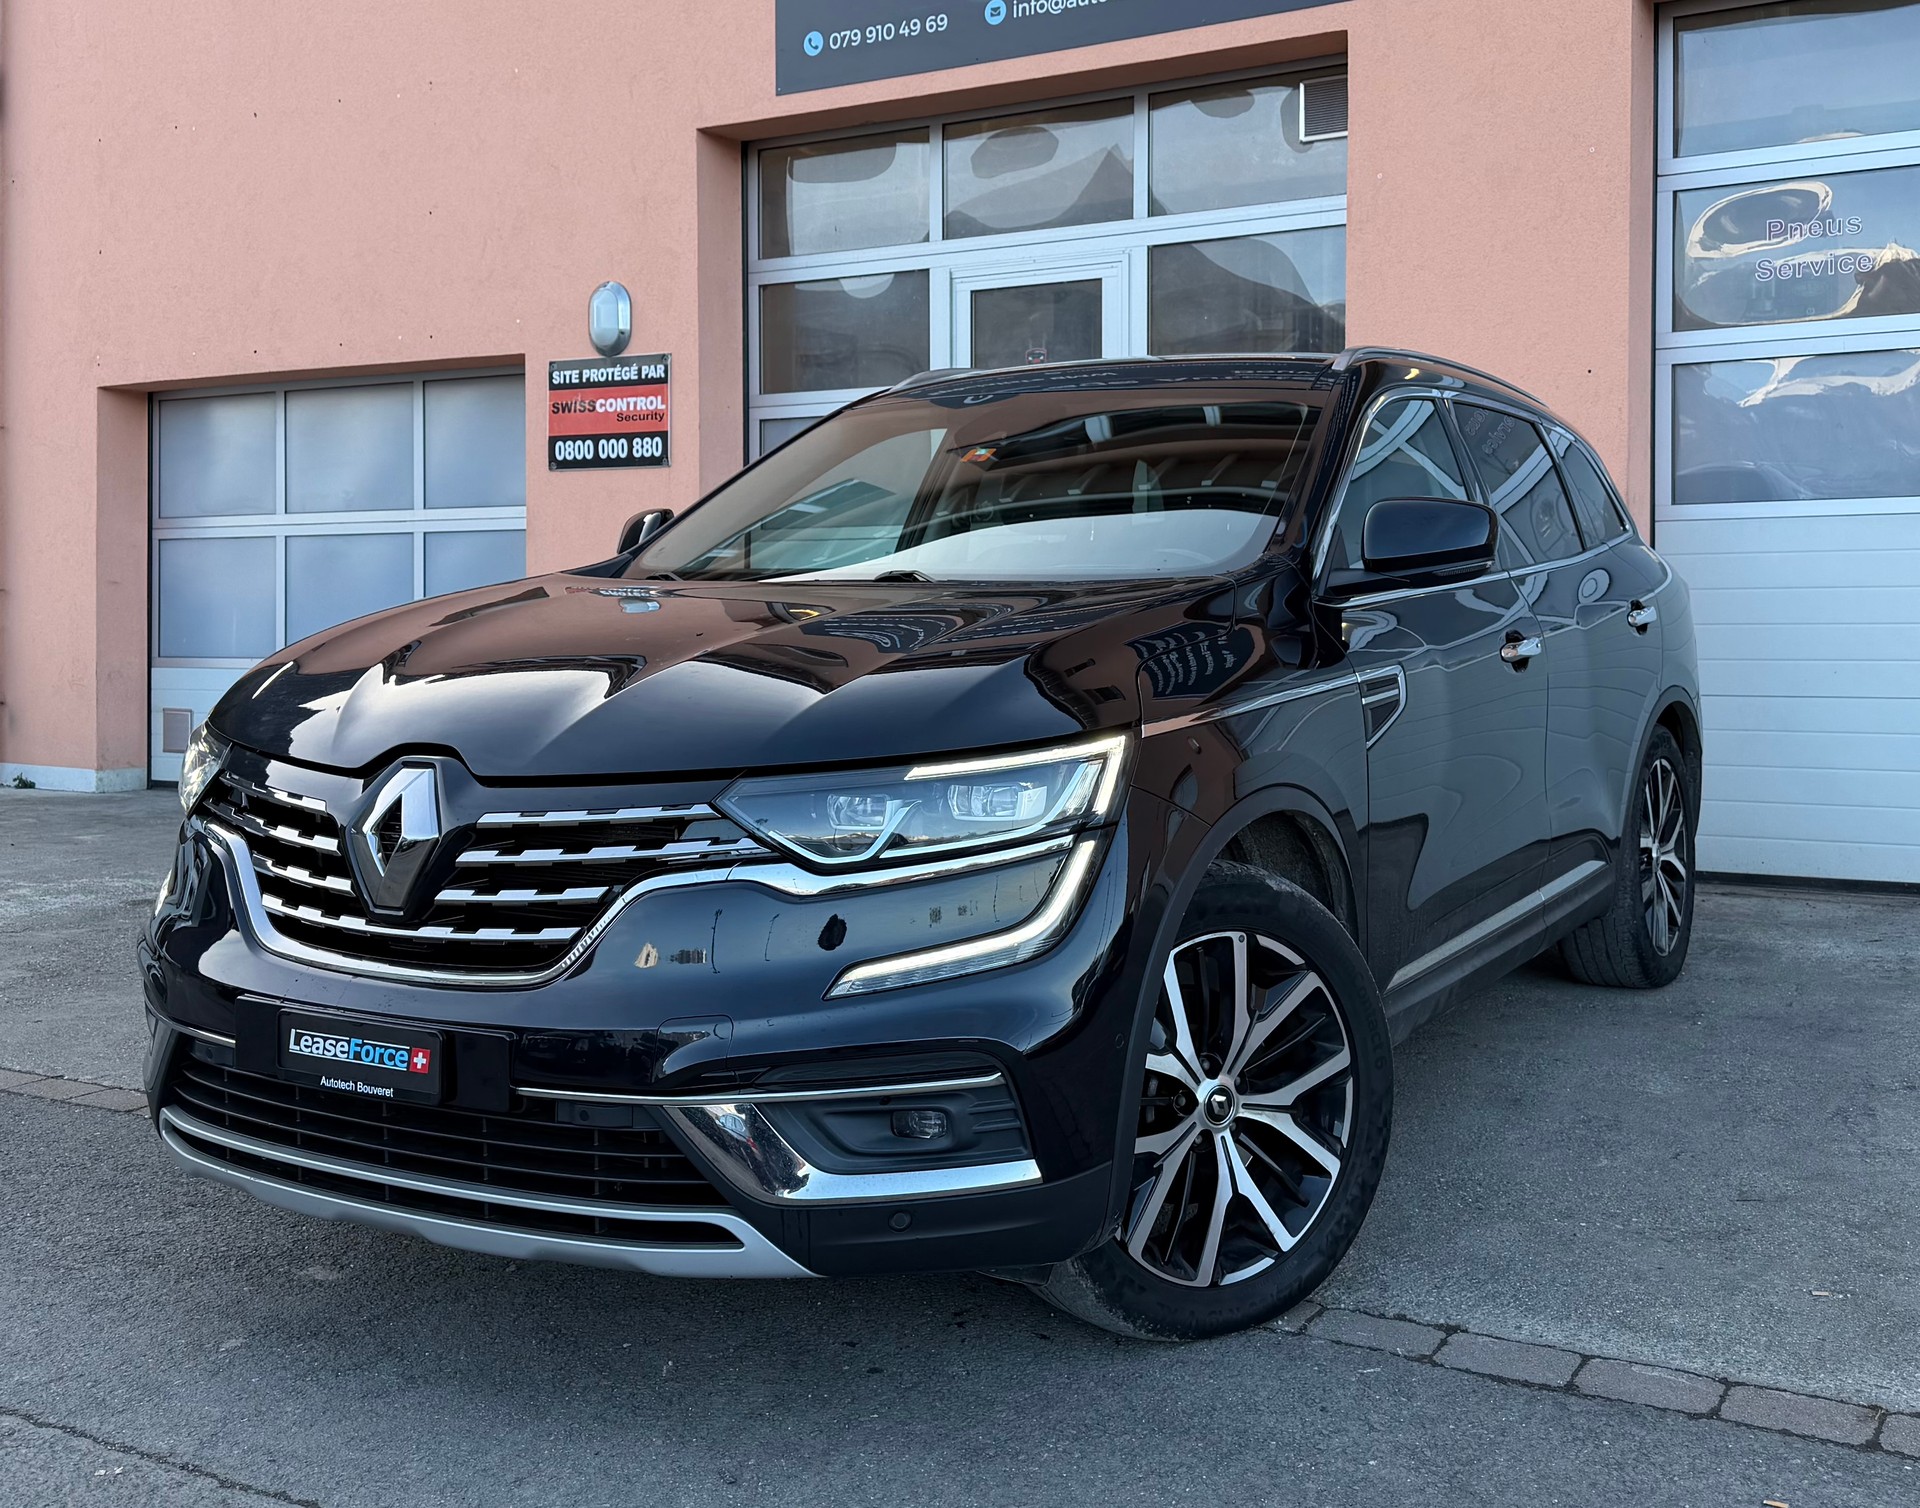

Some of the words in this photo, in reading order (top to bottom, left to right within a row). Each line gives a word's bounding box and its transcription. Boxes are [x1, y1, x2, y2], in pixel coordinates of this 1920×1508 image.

[829, 29, 861, 50] 079
[865, 23, 895, 44] 910
[899, 18, 921, 37] 49
[925, 13, 948, 33] 69
[1766, 216, 1862, 241] Pneus
[1755, 252, 1873, 281] Service
[552, 369, 580, 385] SITE
[582, 363, 638, 382] PROTÉGÉ
[641, 364, 665, 379] PAR
[616, 411, 665, 423] Security
[555, 440, 594, 461] 0800
[598, 438, 628, 459] 000
[632, 436, 662, 458] 880
[289, 1028, 409, 1069] LeaseForce
[320, 1075, 355, 1092] Autotech
[357, 1082, 394, 1098] Bouveret
